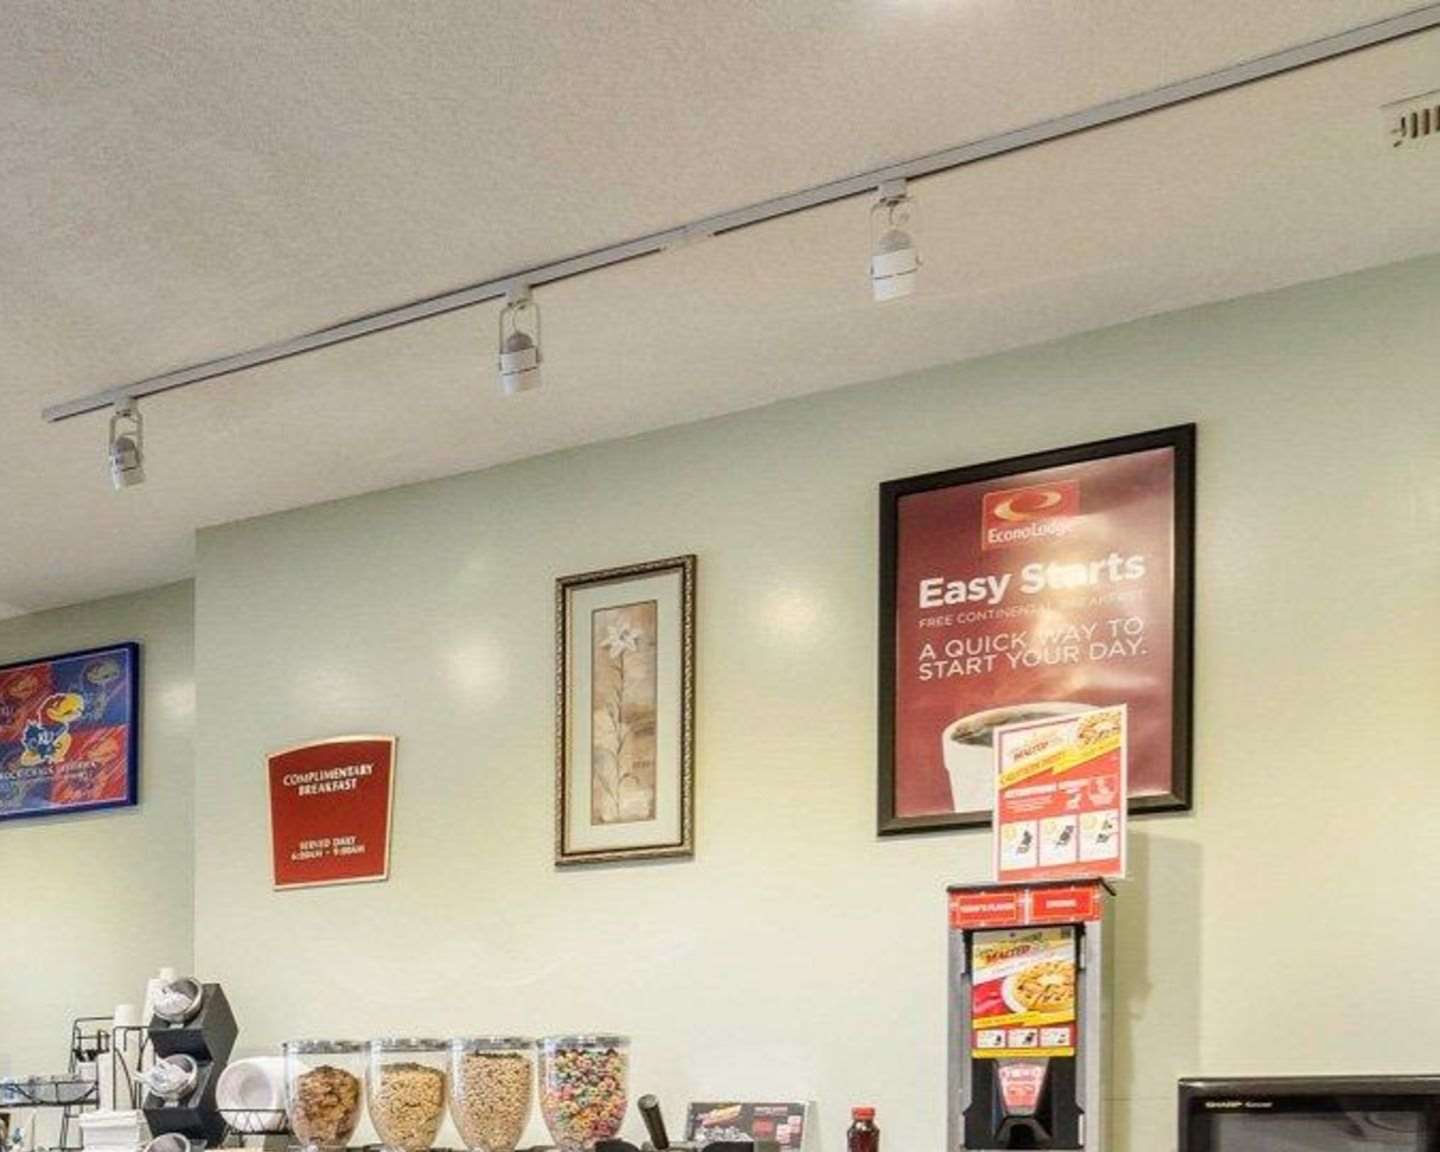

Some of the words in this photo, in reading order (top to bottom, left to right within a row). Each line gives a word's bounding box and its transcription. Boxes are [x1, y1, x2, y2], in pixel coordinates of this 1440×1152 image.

[918, 572, 1012, 608] Easy
[1021, 553, 1147, 594] Starts
[918, 613, 953, 629] FREE
[918, 643, 937, 662] A
[944, 632, 1028, 659] QUICK
[1040, 623, 1098, 645] WAY
[1108, 616, 1145, 636] TO
[918, 655, 1000, 682] START
[1005, 645, 1081, 669] YOUR
[1088, 636, 1149, 661] DAY.
[283, 764, 374, 786] COMPLIMENTARY
[298, 778, 358, 796] BREAKFAST
